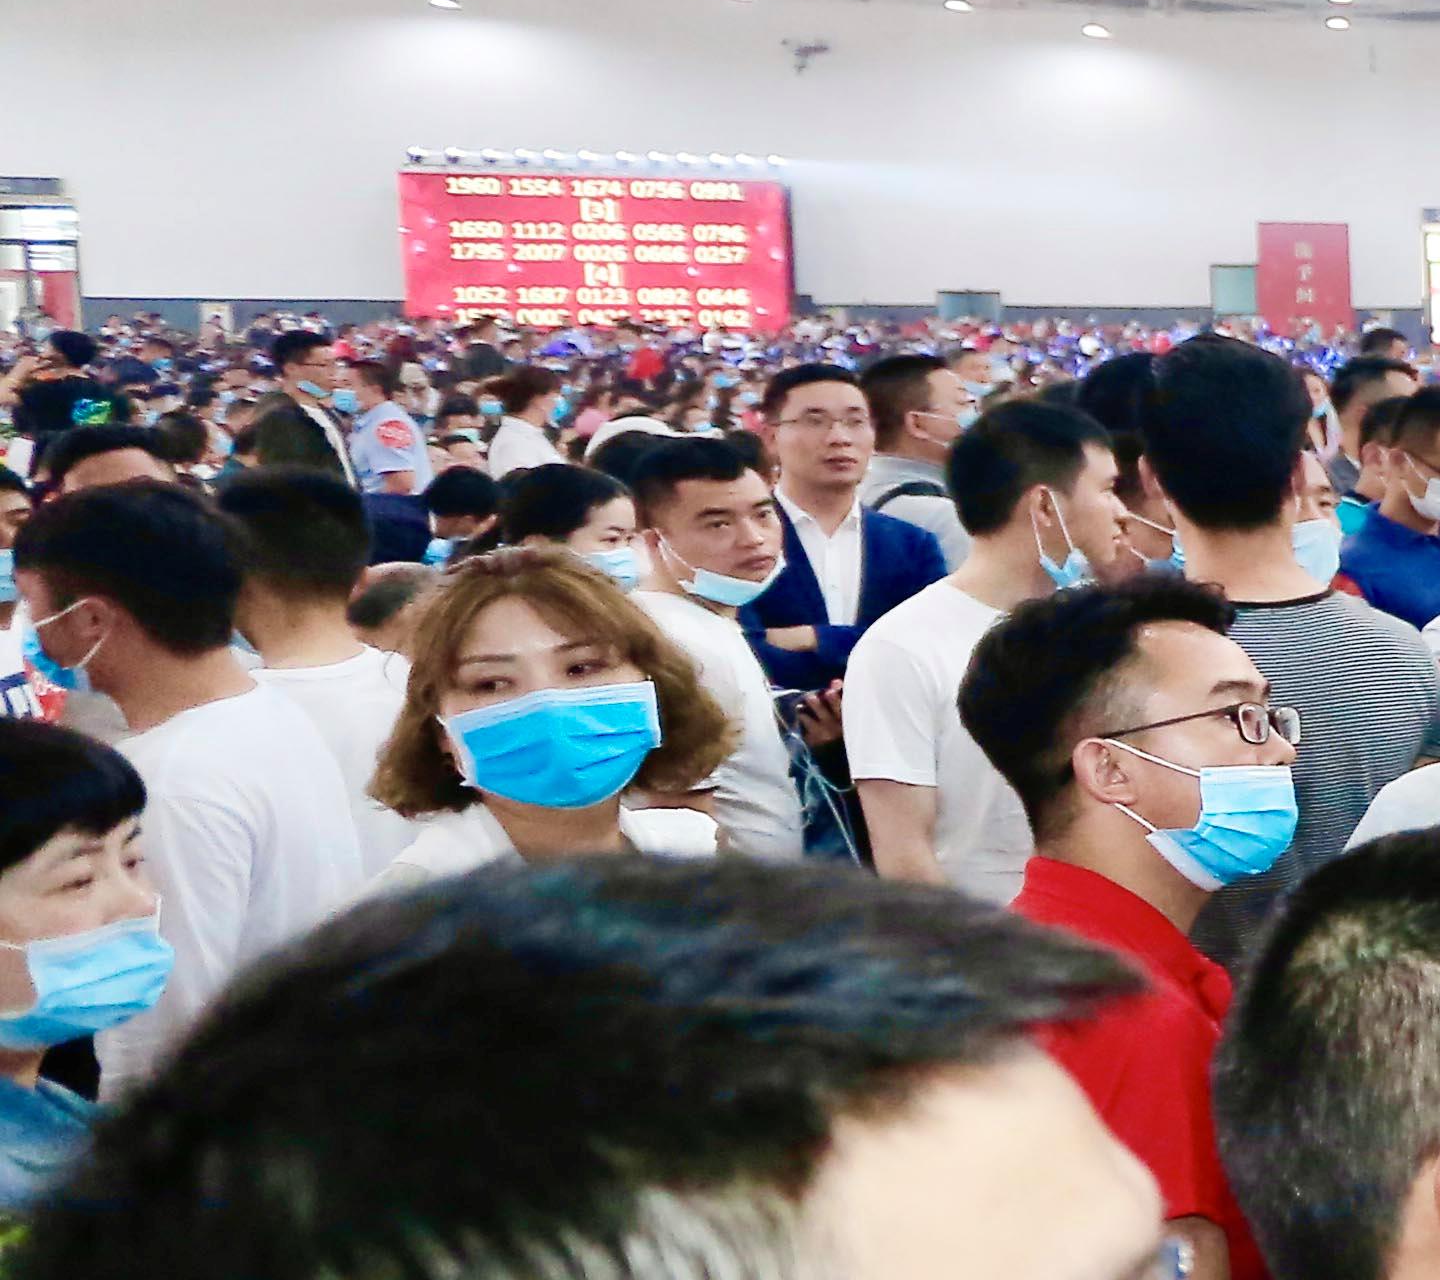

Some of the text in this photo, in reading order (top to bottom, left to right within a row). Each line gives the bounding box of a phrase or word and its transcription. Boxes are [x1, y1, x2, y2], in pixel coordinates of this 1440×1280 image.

[511, 222, 567, 240] 1112
[511, 243, 567, 262] 2007
[693, 245, 748, 264] 0257
[453, 286, 508, 304] 1052
[576, 287, 632, 306] 0123
